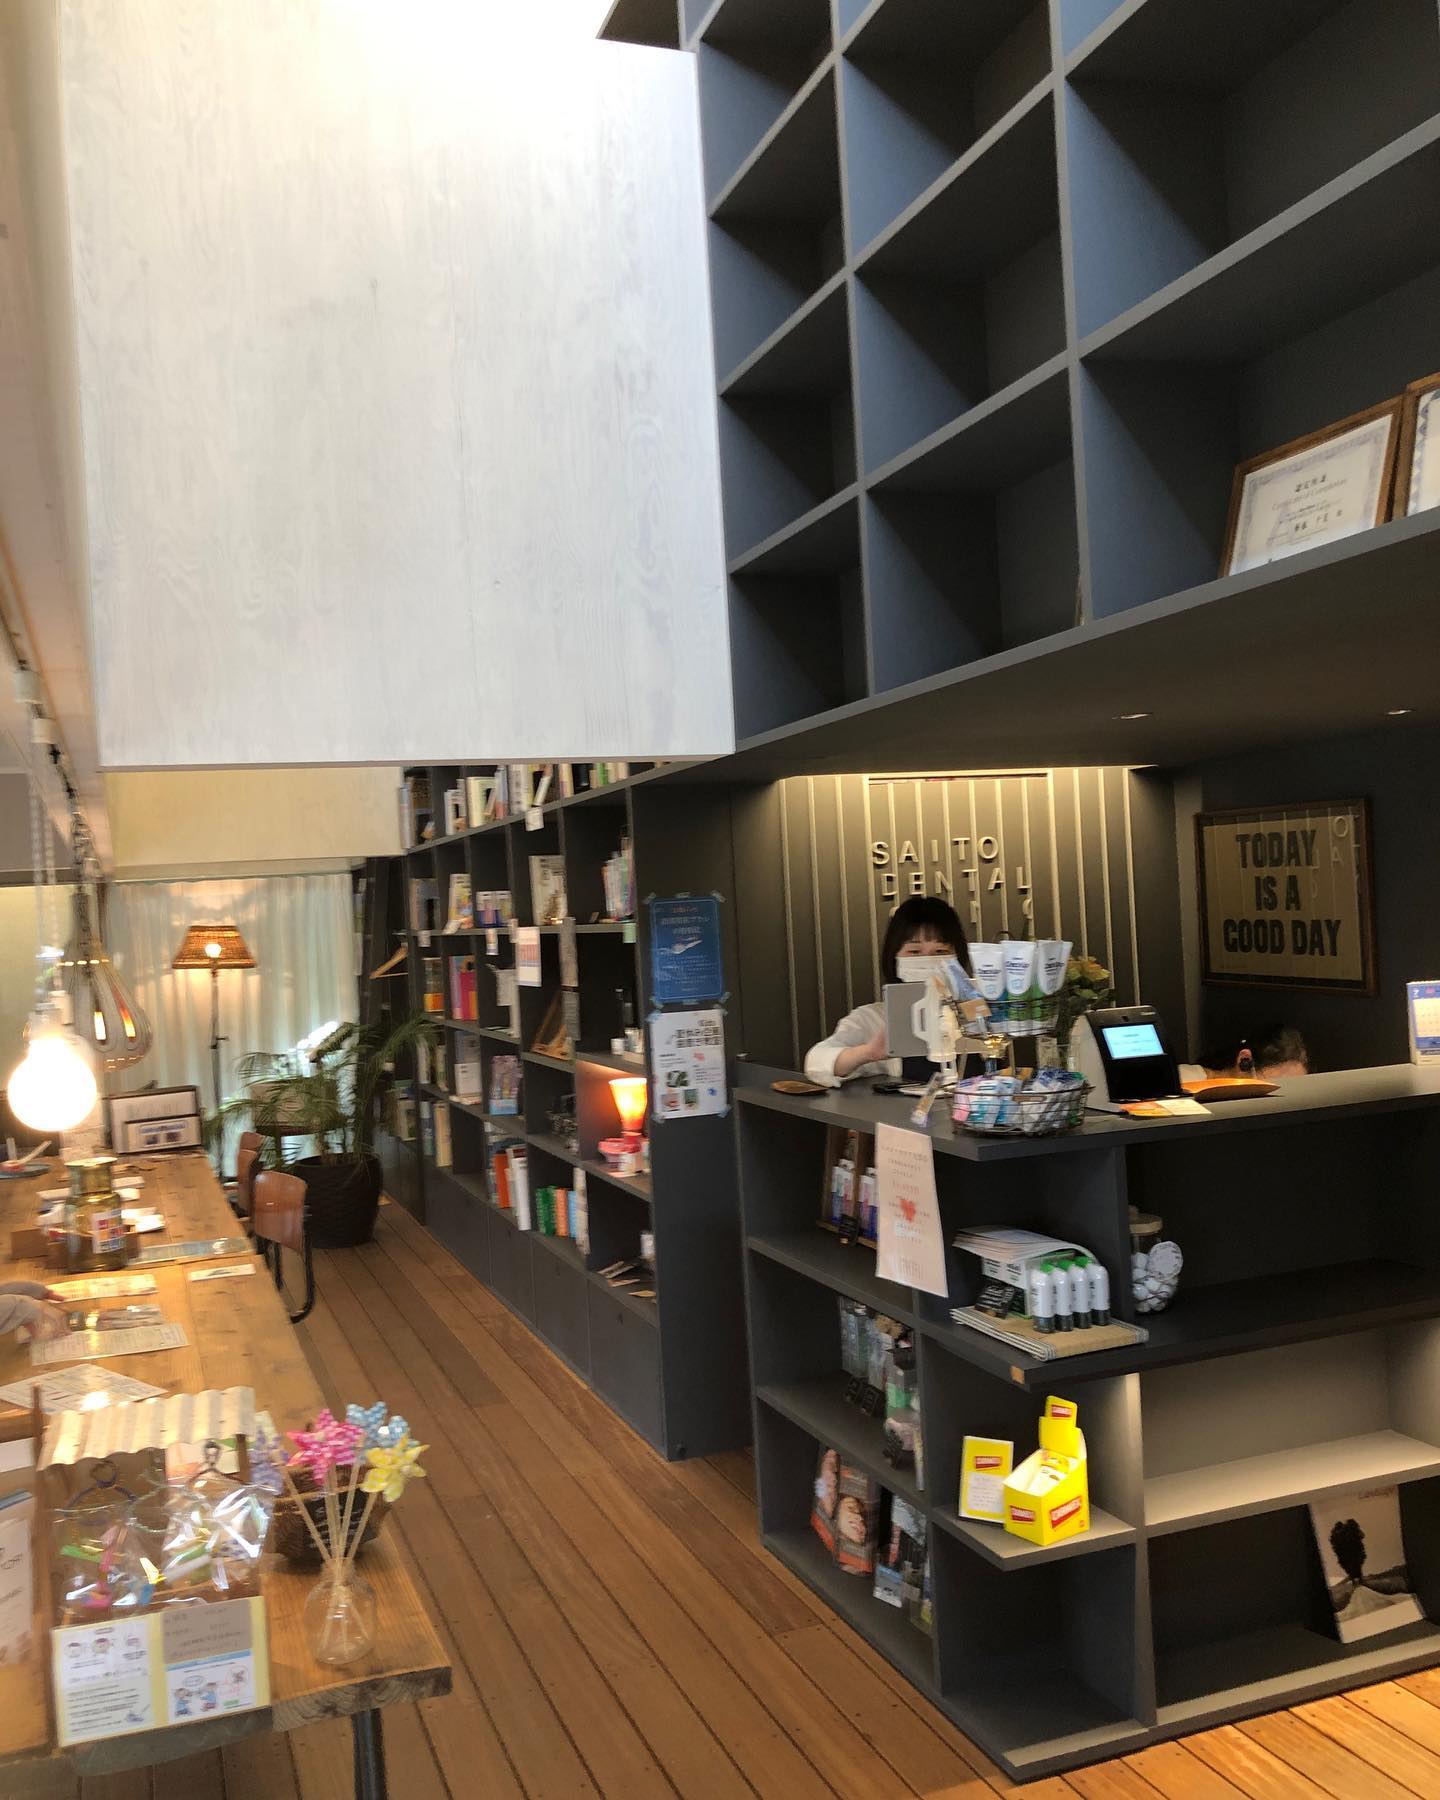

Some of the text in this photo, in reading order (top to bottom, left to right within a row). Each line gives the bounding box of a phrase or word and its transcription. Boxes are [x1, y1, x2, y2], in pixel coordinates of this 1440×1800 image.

[872, 836, 999, 865] SAITO
[1236, 830, 1317, 869] TODAY
[881, 866, 1031, 897] DENTAL
[1255, 874, 1302, 912] IS A
[1223, 918, 1342, 957] GOOD DAY
